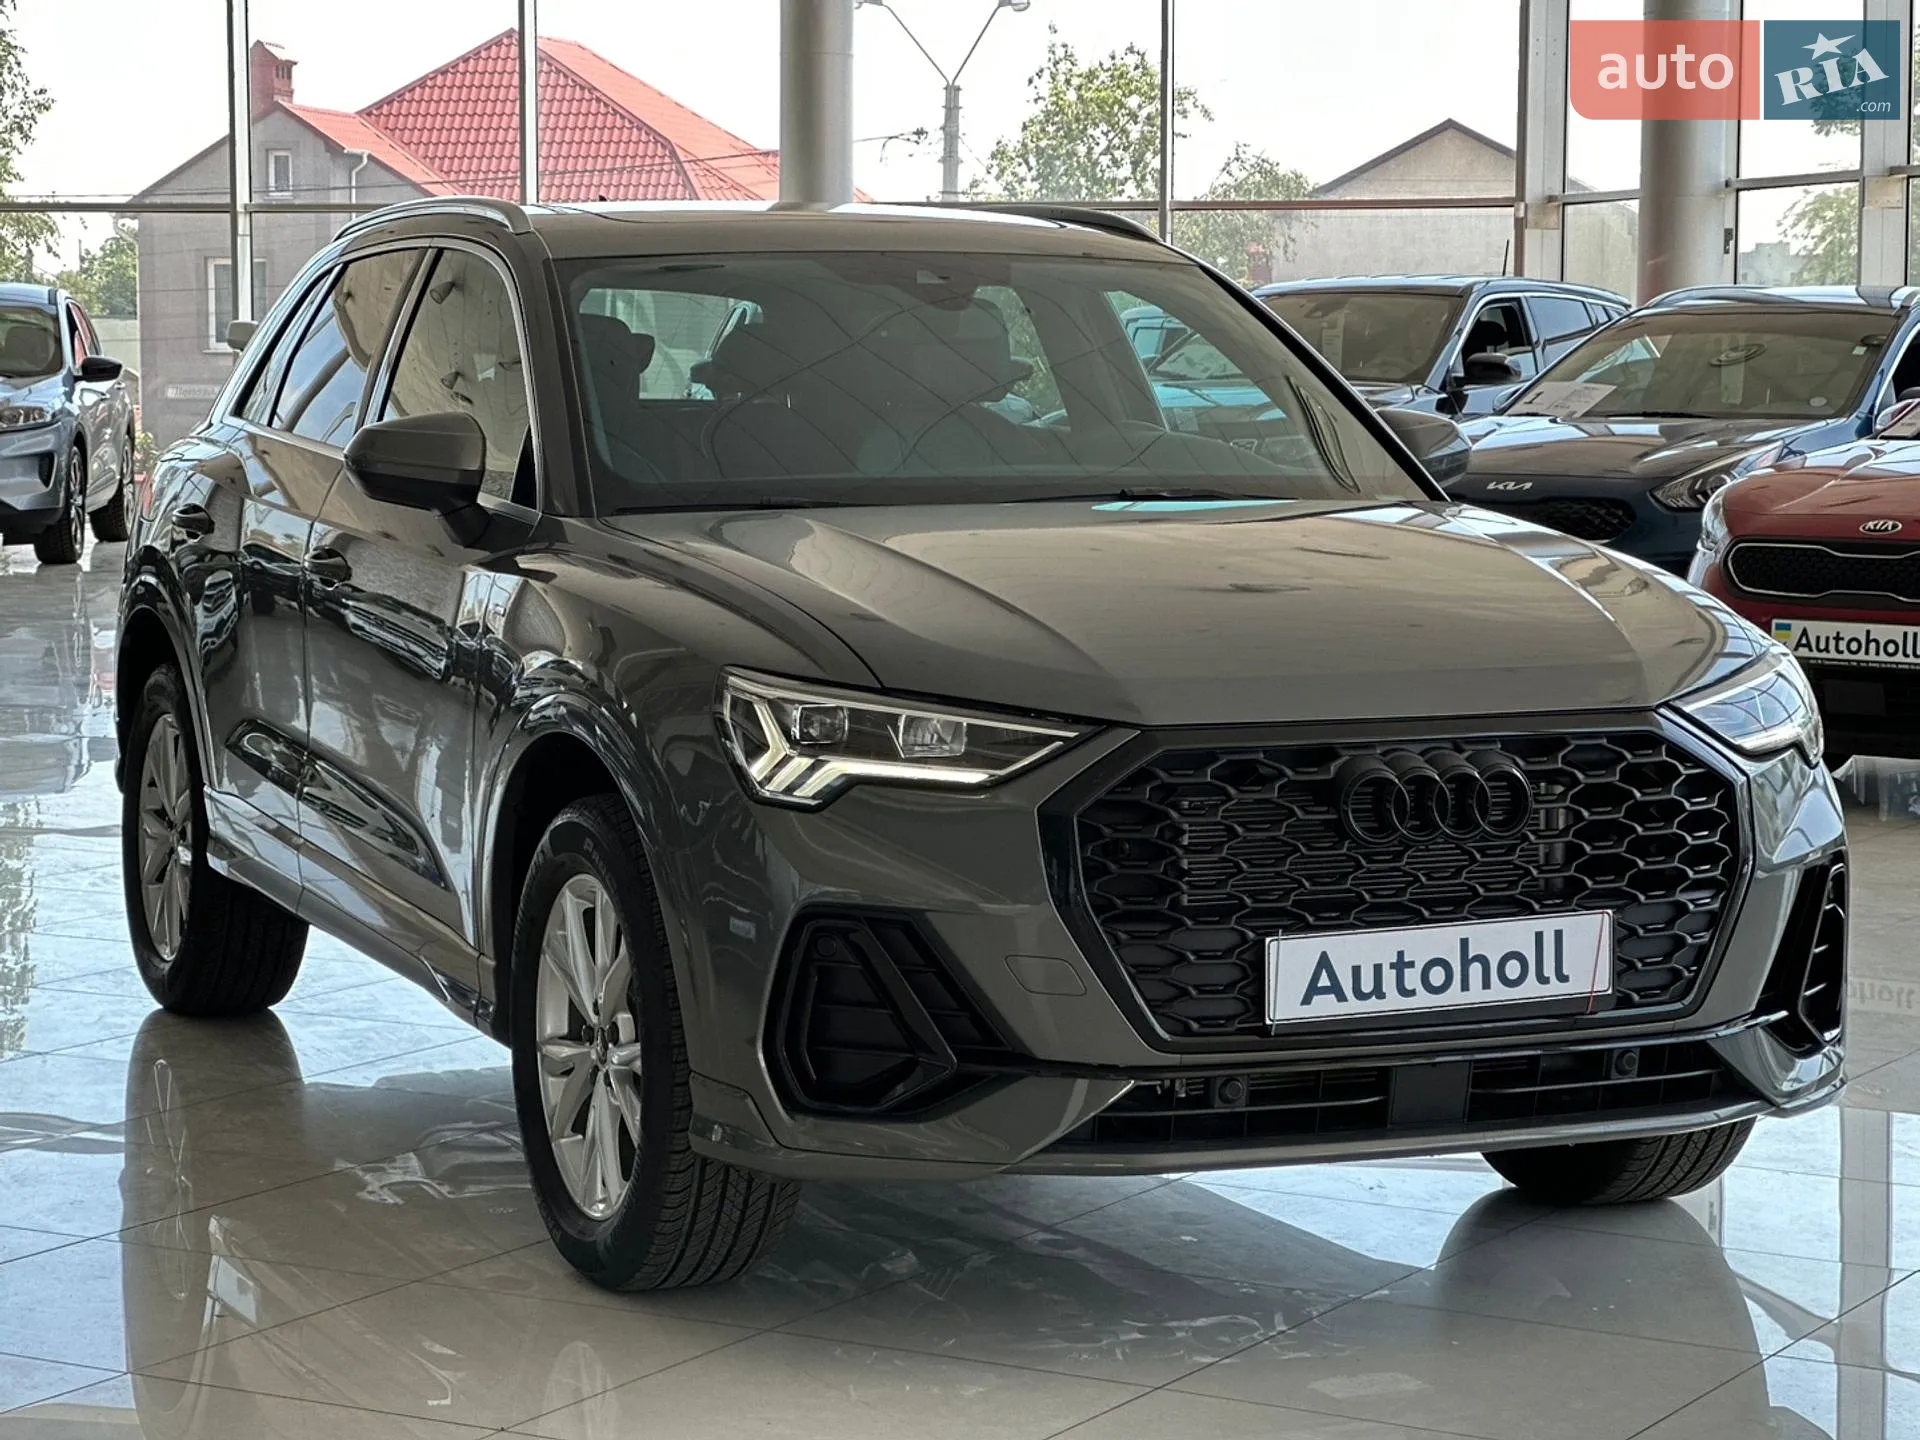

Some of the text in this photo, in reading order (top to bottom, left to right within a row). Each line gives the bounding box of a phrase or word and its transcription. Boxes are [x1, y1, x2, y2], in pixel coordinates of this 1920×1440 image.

[1862, 519, 1897, 532] KIA
[1793, 626, 1920, 659] Autoholl
[1299, 928, 1570, 1006] Autoholl
